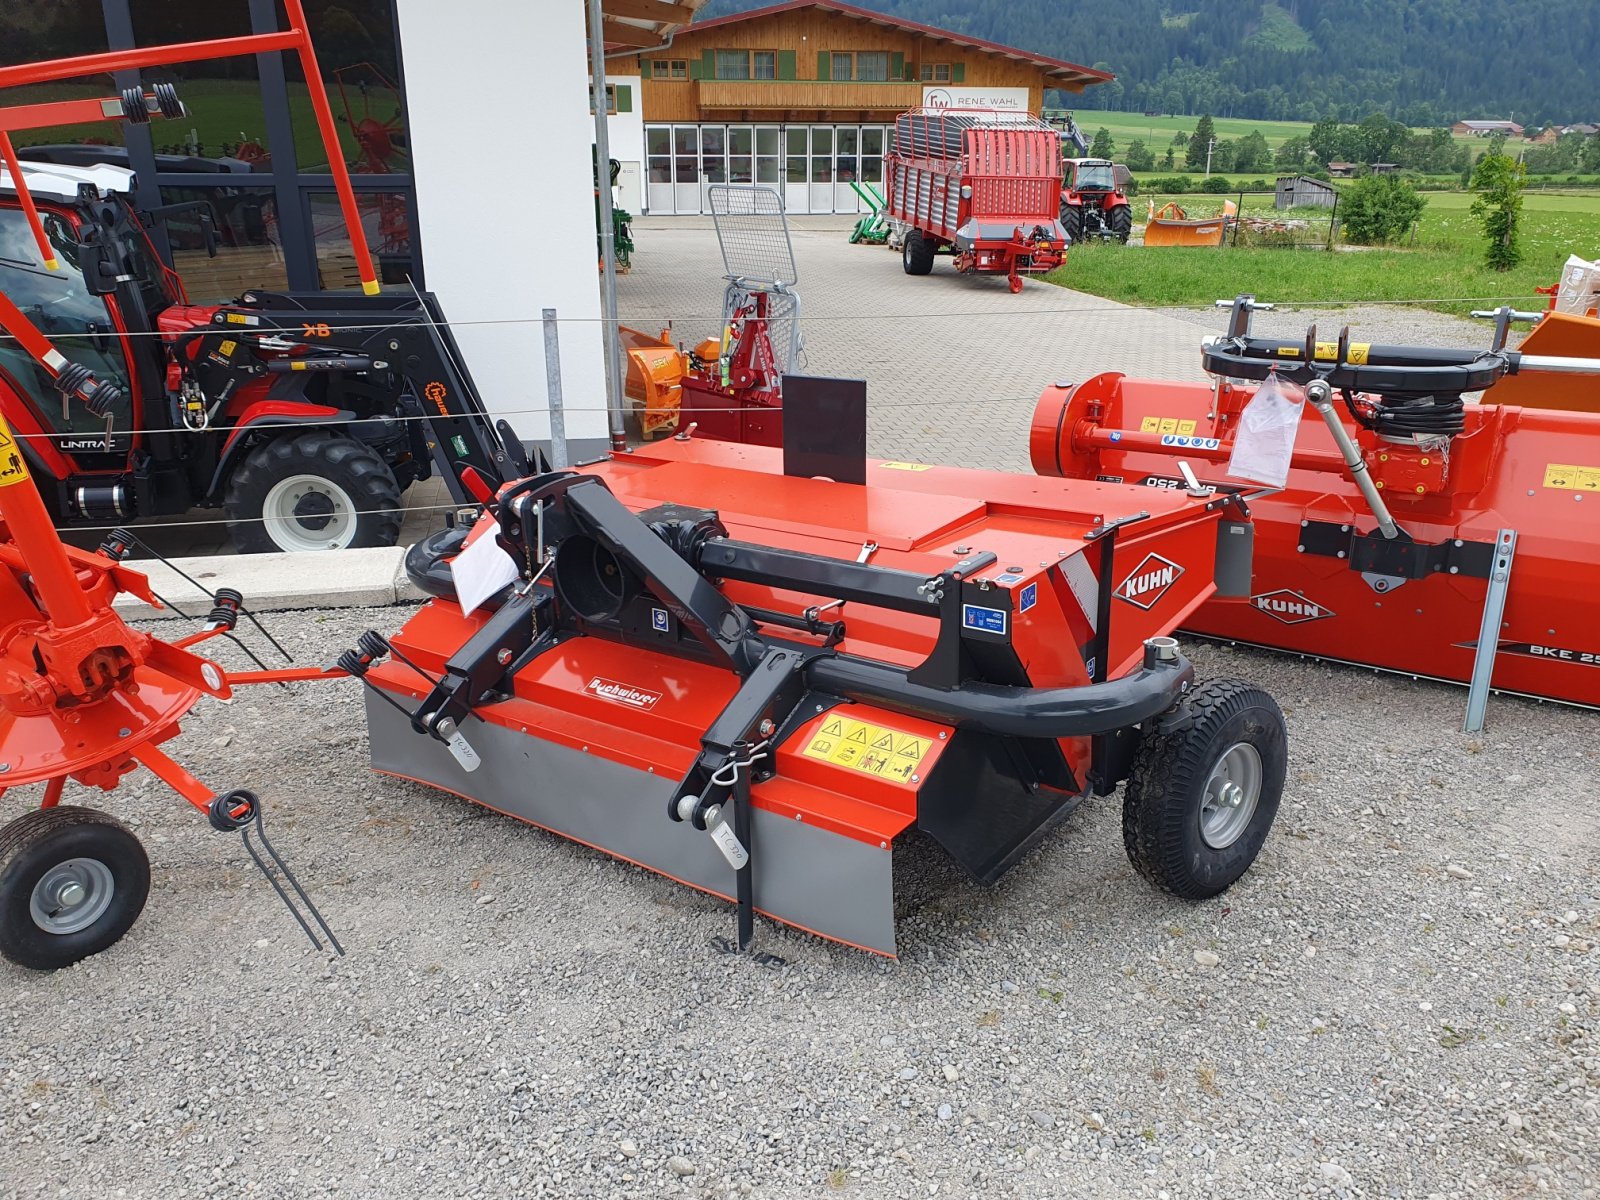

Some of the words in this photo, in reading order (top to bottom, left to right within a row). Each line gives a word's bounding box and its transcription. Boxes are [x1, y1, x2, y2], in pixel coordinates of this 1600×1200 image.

[958, 97, 985, 105] RENE
[990, 97, 1018, 105] WAHL
[1125, 566, 1174, 598] KUHN
[1257, 597, 1319, 617] KUHN
[1529, 645, 1573, 659] BKE
